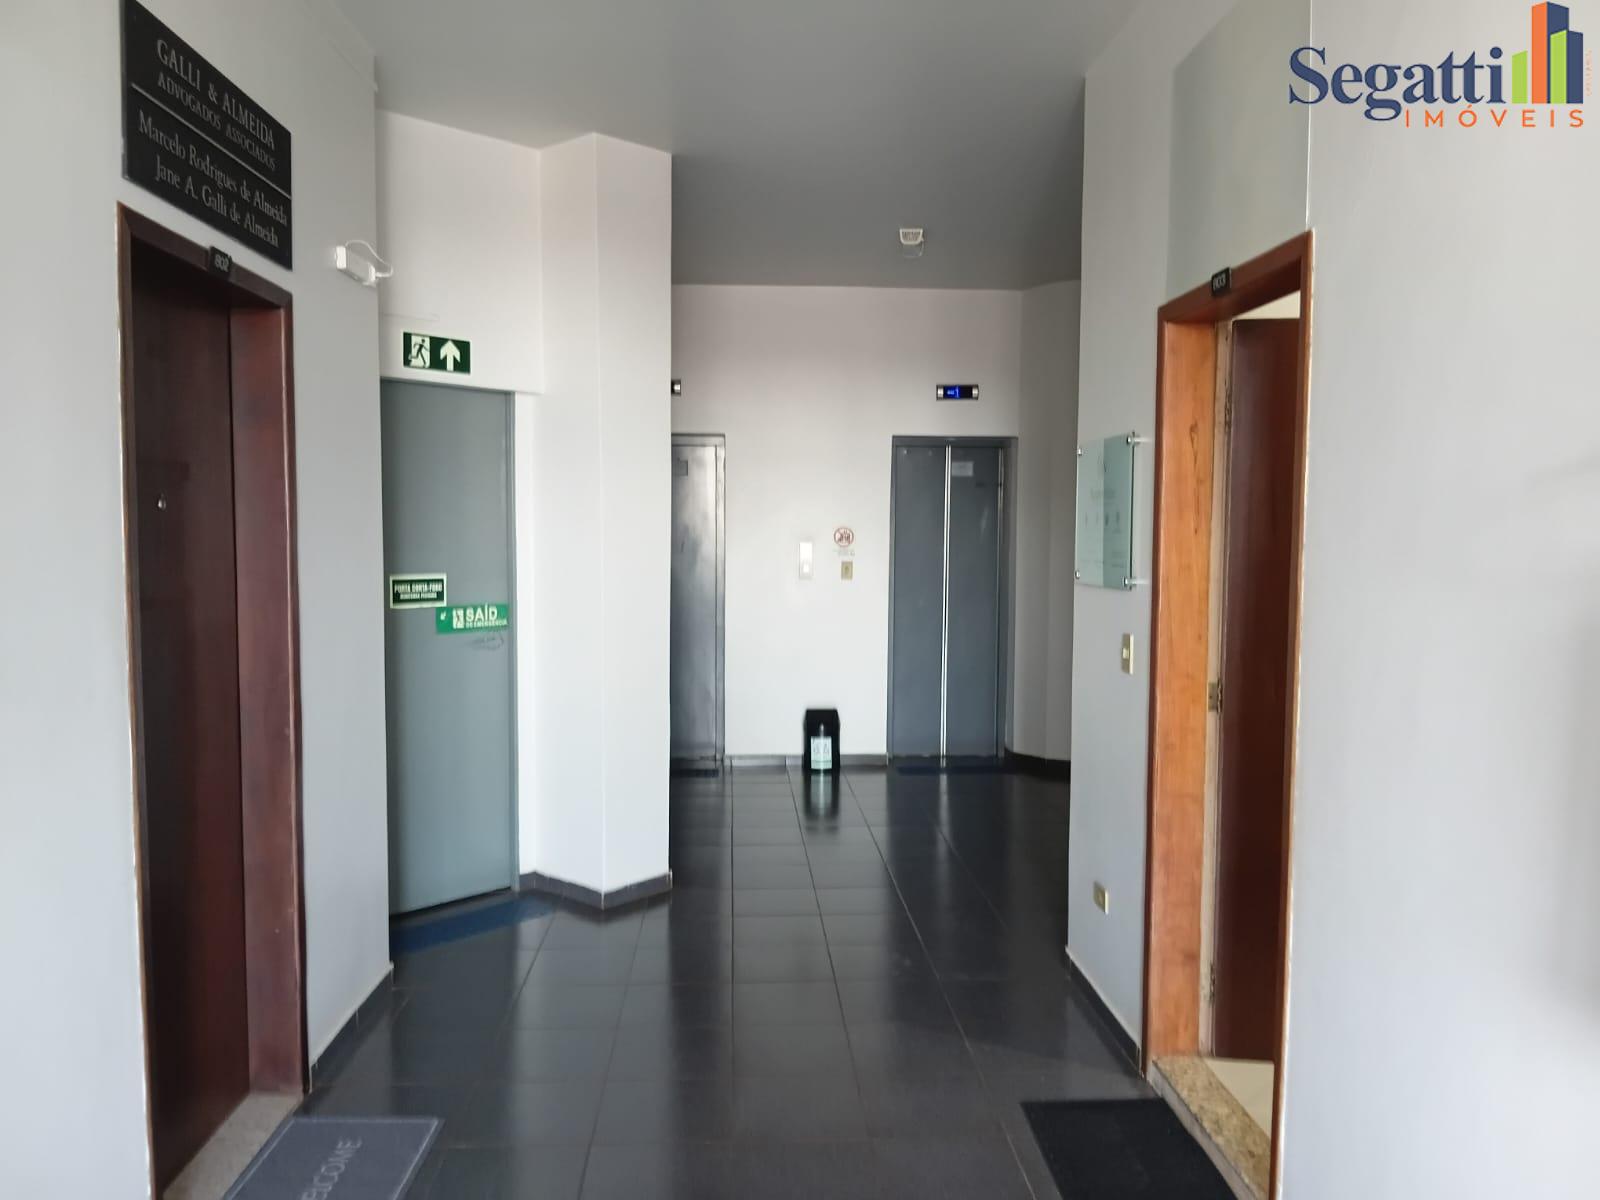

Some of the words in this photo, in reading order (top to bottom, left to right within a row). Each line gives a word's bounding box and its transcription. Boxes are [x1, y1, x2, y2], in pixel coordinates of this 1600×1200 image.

[157, 39, 201, 91] GALLI
[208, 83, 218, 105] &
[222, 92, 275, 151] ALMEIDA
[157, 71, 222, 131] ADVOGADOS
[225, 123, 276, 171] ASSOCIADOS
[138, 110, 185, 160] Marcelo
[189, 143, 237, 192] Rodrigues
[240, 181, 251, 203] de
[253, 191, 288, 226] Almeida
[155, 154, 181, 188] Jane
[184, 175, 198, 201] A.
[202, 184, 227, 217] Galli
[230, 202, 241, 225] de
[244, 215, 279, 249] Almeida
